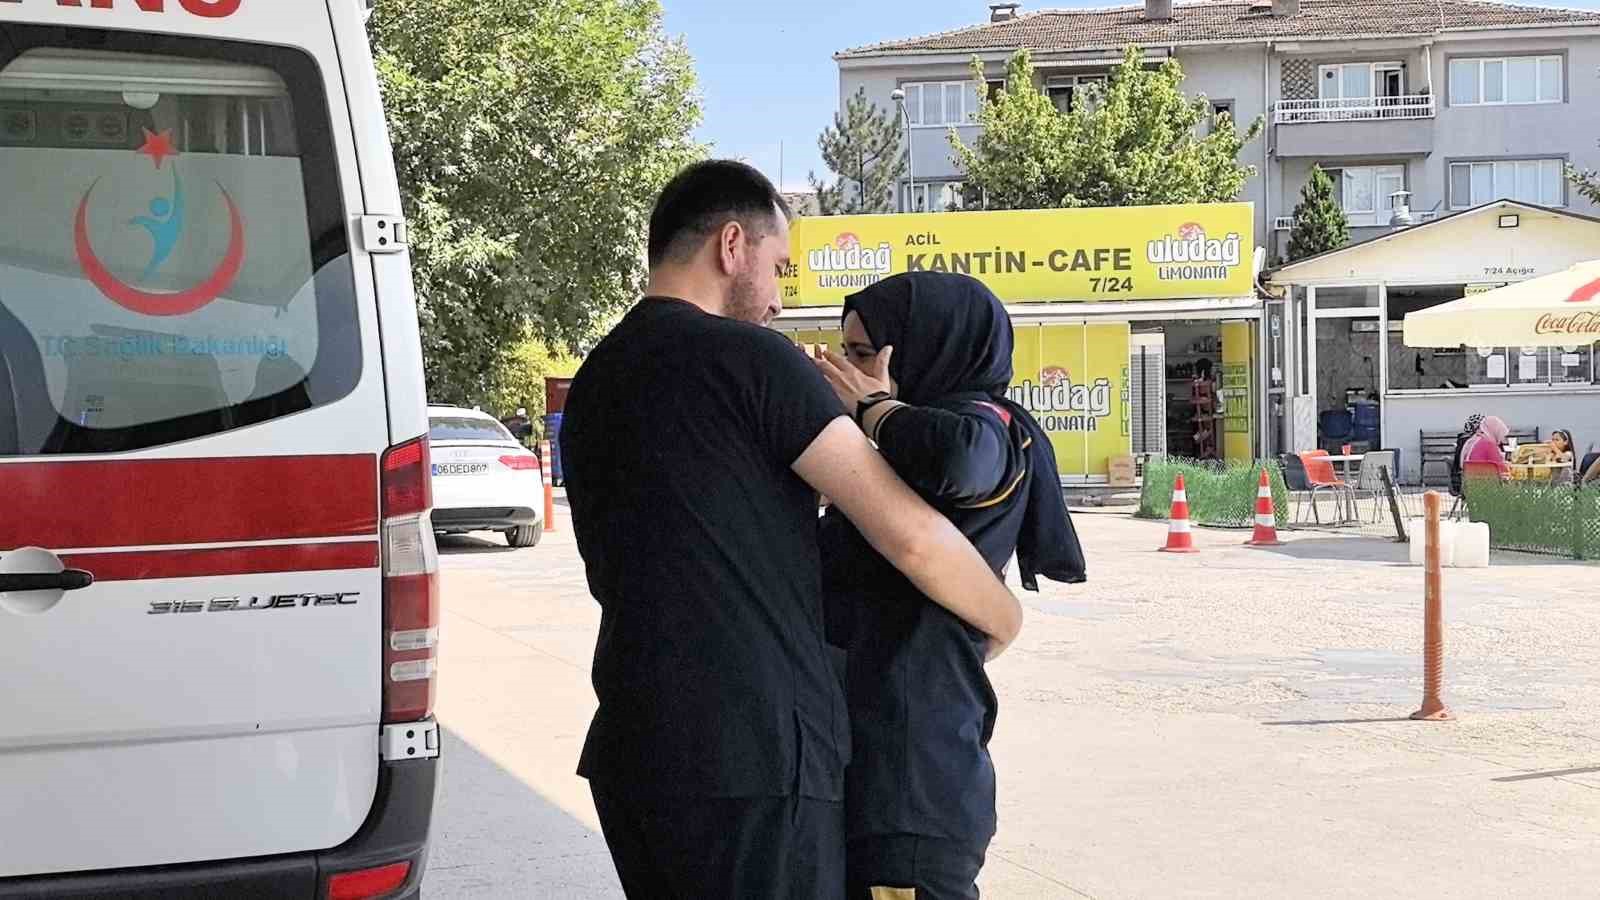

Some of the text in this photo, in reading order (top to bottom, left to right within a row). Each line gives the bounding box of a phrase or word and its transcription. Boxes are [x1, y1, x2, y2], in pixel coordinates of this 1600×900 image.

[808, 241, 892, 274] uludağ
[1146, 232, 1241, 266] uludağ
[1089, 277, 1134, 293] 7/24
